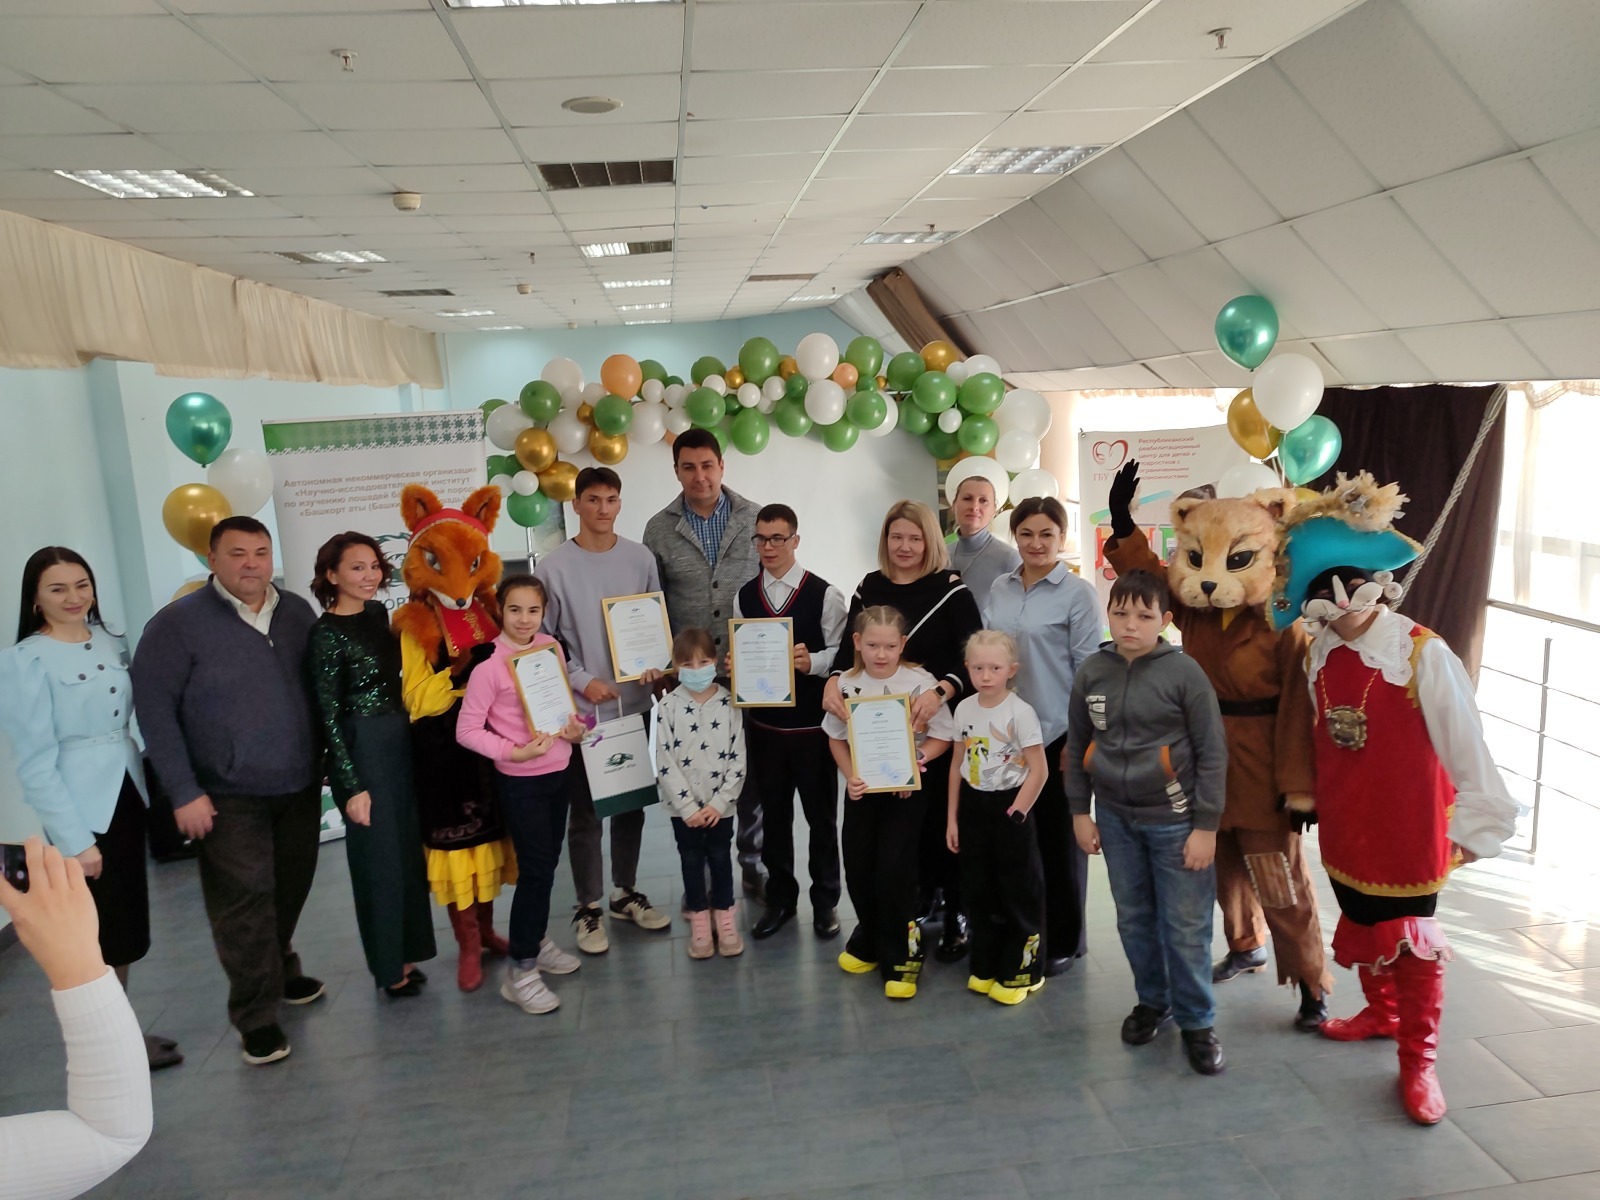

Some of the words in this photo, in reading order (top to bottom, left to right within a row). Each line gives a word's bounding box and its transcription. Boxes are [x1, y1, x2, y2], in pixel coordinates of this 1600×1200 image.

[283, 477, 342, 487] Автономная
[345, 471, 420, 482] некоммерческая
[429, 477, 470, 486] институт
[299, 497, 346, 507] изучению
[348, 493, 389, 502] лошадей
